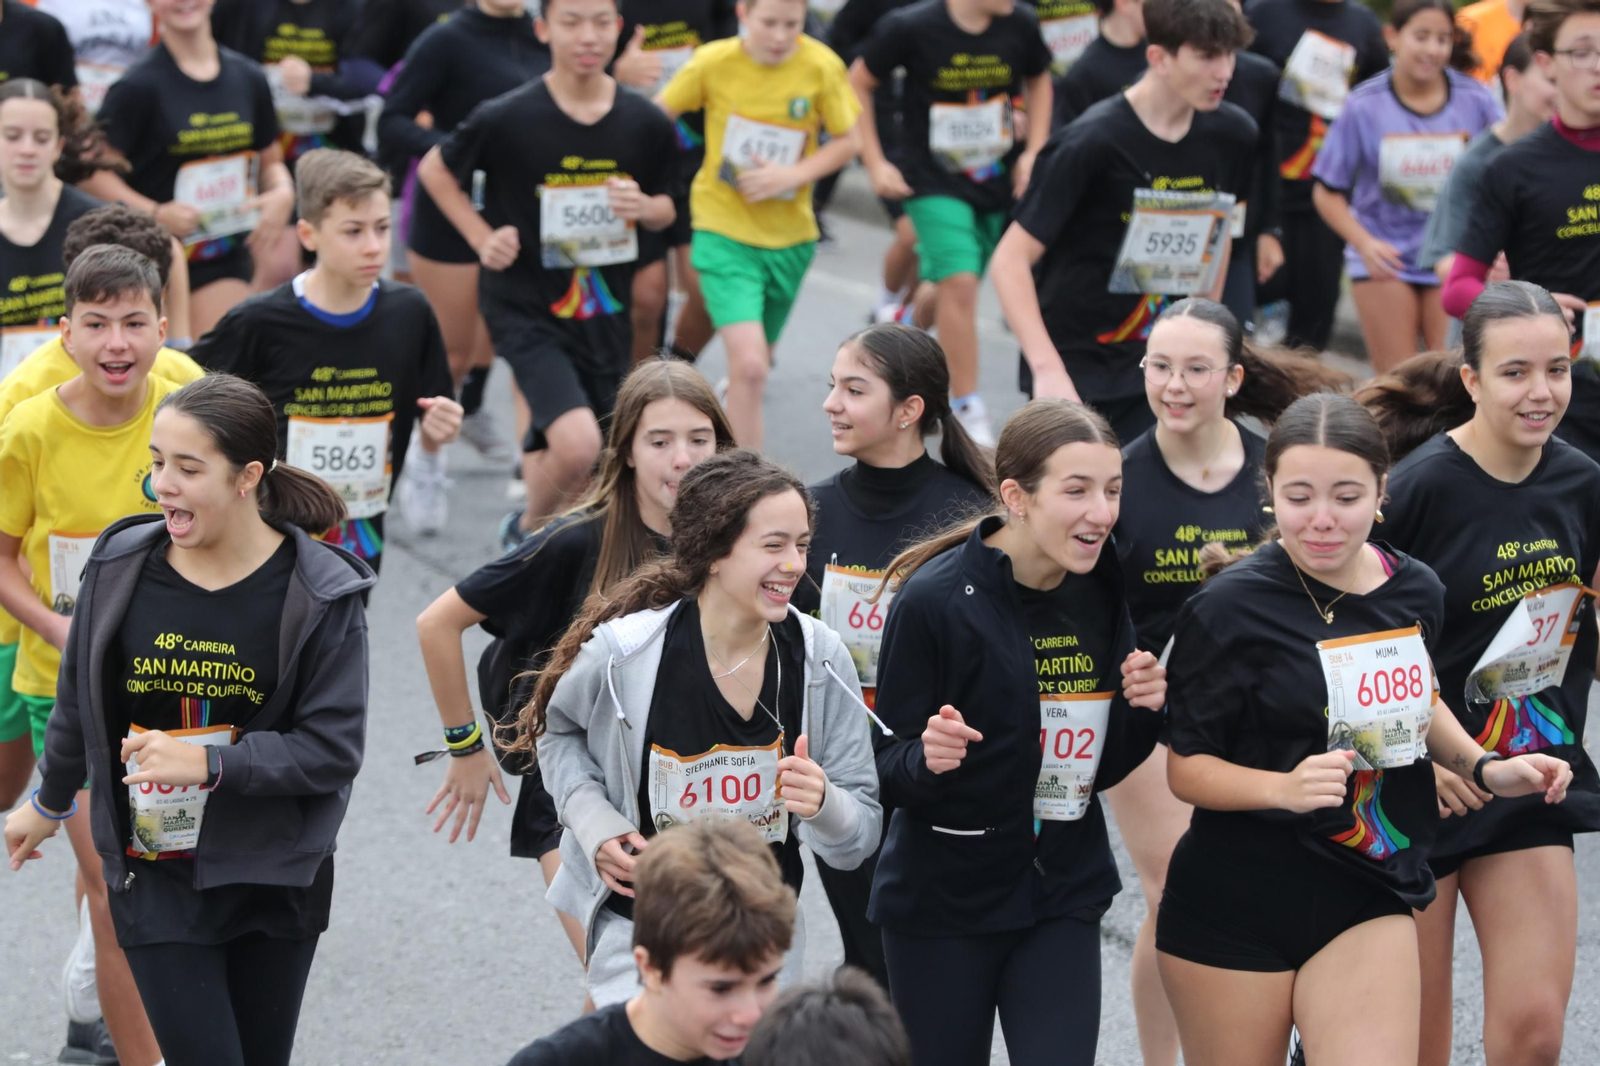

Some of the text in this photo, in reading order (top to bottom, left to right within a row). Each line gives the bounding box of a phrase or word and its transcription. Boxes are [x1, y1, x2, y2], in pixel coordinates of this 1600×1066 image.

[1144, 231, 1199, 255] 5935
[294, 387, 325, 402] SAN
[312, 445, 377, 471] 5863
[1175, 525, 1247, 542] 48º CARREIRA
[1155, 547, 1188, 567] SAN
[1497, 541, 1520, 560] 48º
[1144, 570, 1207, 583] CONCELLO
[1483, 567, 1514, 592] SAN
[1472, 581, 1534, 612] CONCELLO
[848, 601, 890, 630] 66
[1526, 612, 1559, 646] 37
[154, 632, 236, 655] 48º CARREIRA
[1034, 635, 1079, 650] CARREIRA
[1375, 646, 1398, 659] MUMA
[1329, 652, 1354, 664] SUB 14
[133, 657, 256, 683] SAN MARTIÑO
[126, 679, 265, 705] CONCELLO DE OURENSE
[1357, 664, 1423, 707] 6088
[1046, 707, 1068, 718] VERA
[660, 760, 673, 770] SUB
[686, 754, 756, 777] STEPHANIE SOFÍA
[680, 773, 761, 809] 6100
